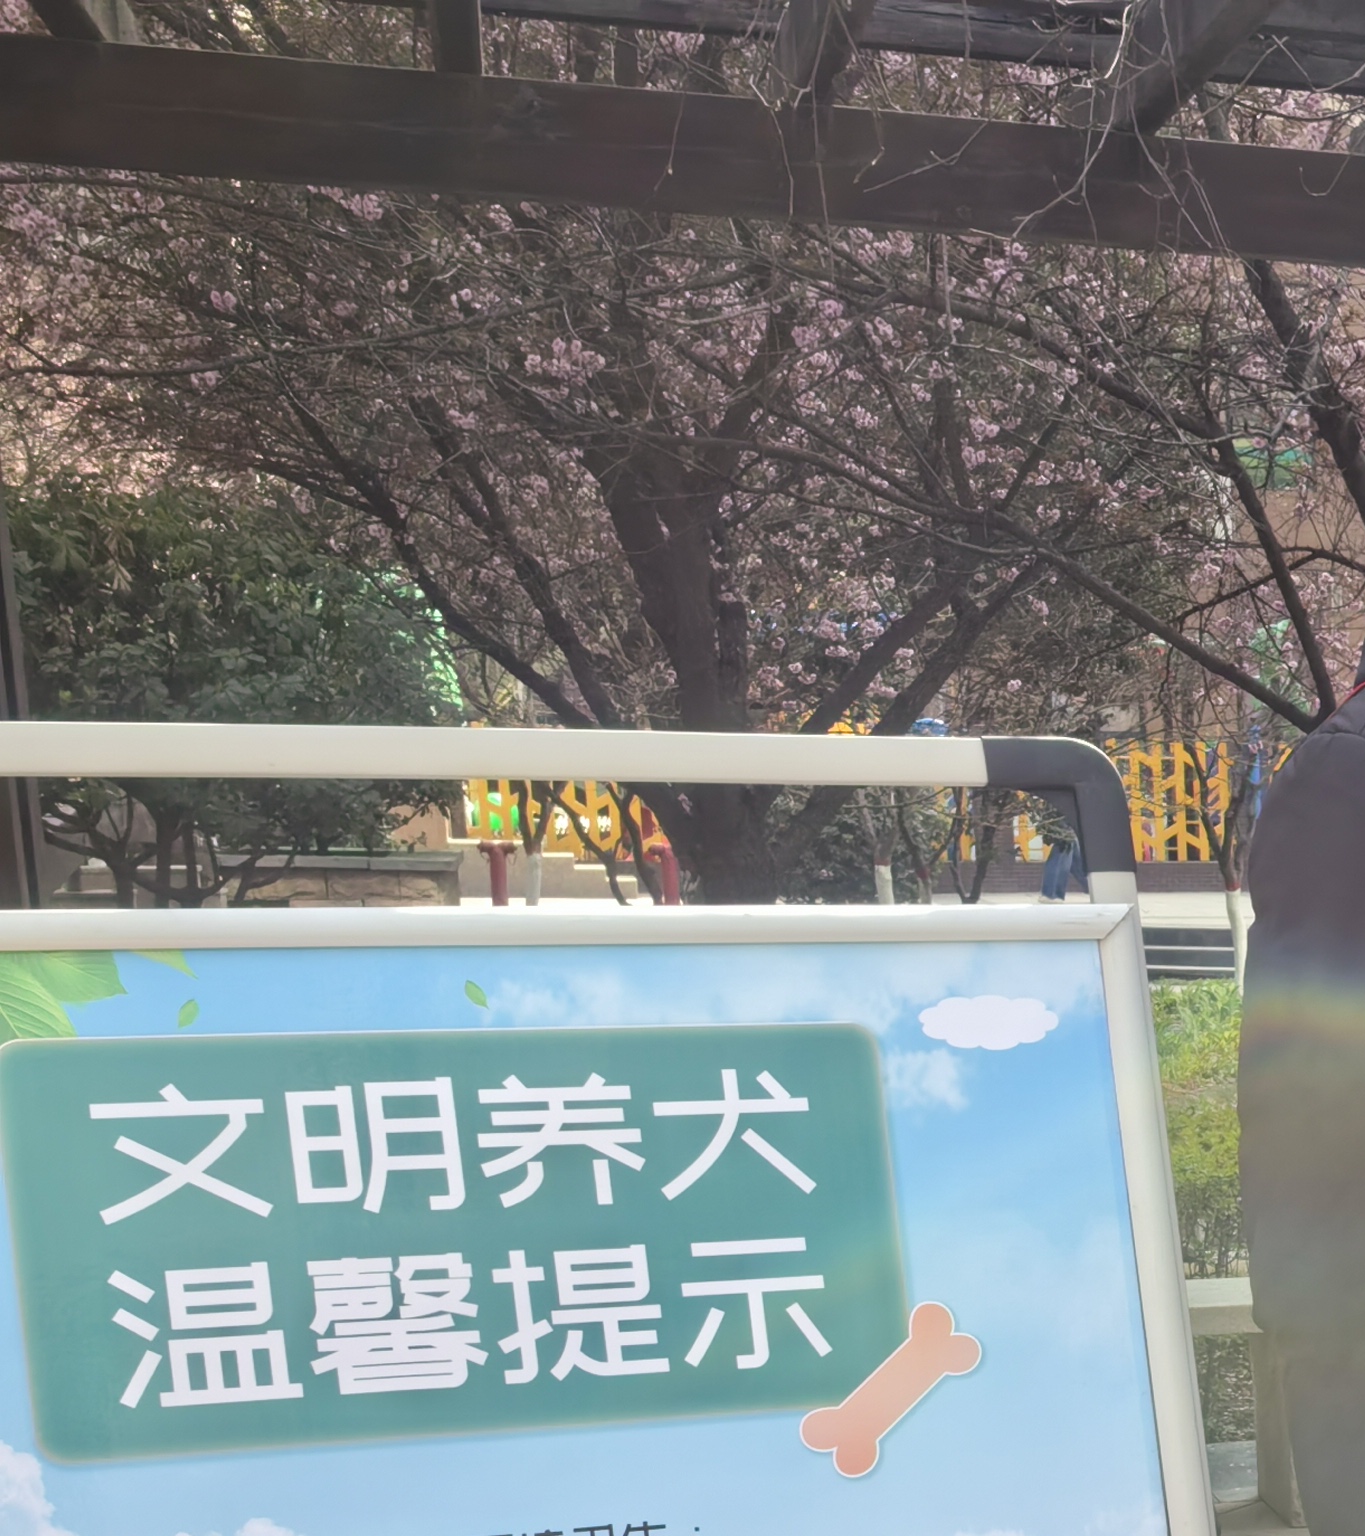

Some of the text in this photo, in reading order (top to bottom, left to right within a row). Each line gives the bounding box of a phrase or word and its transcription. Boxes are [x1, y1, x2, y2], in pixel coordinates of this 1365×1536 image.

[88, 1068, 818, 1226] 文明养犬
[107, 1237, 833, 1409] 温馨提示
